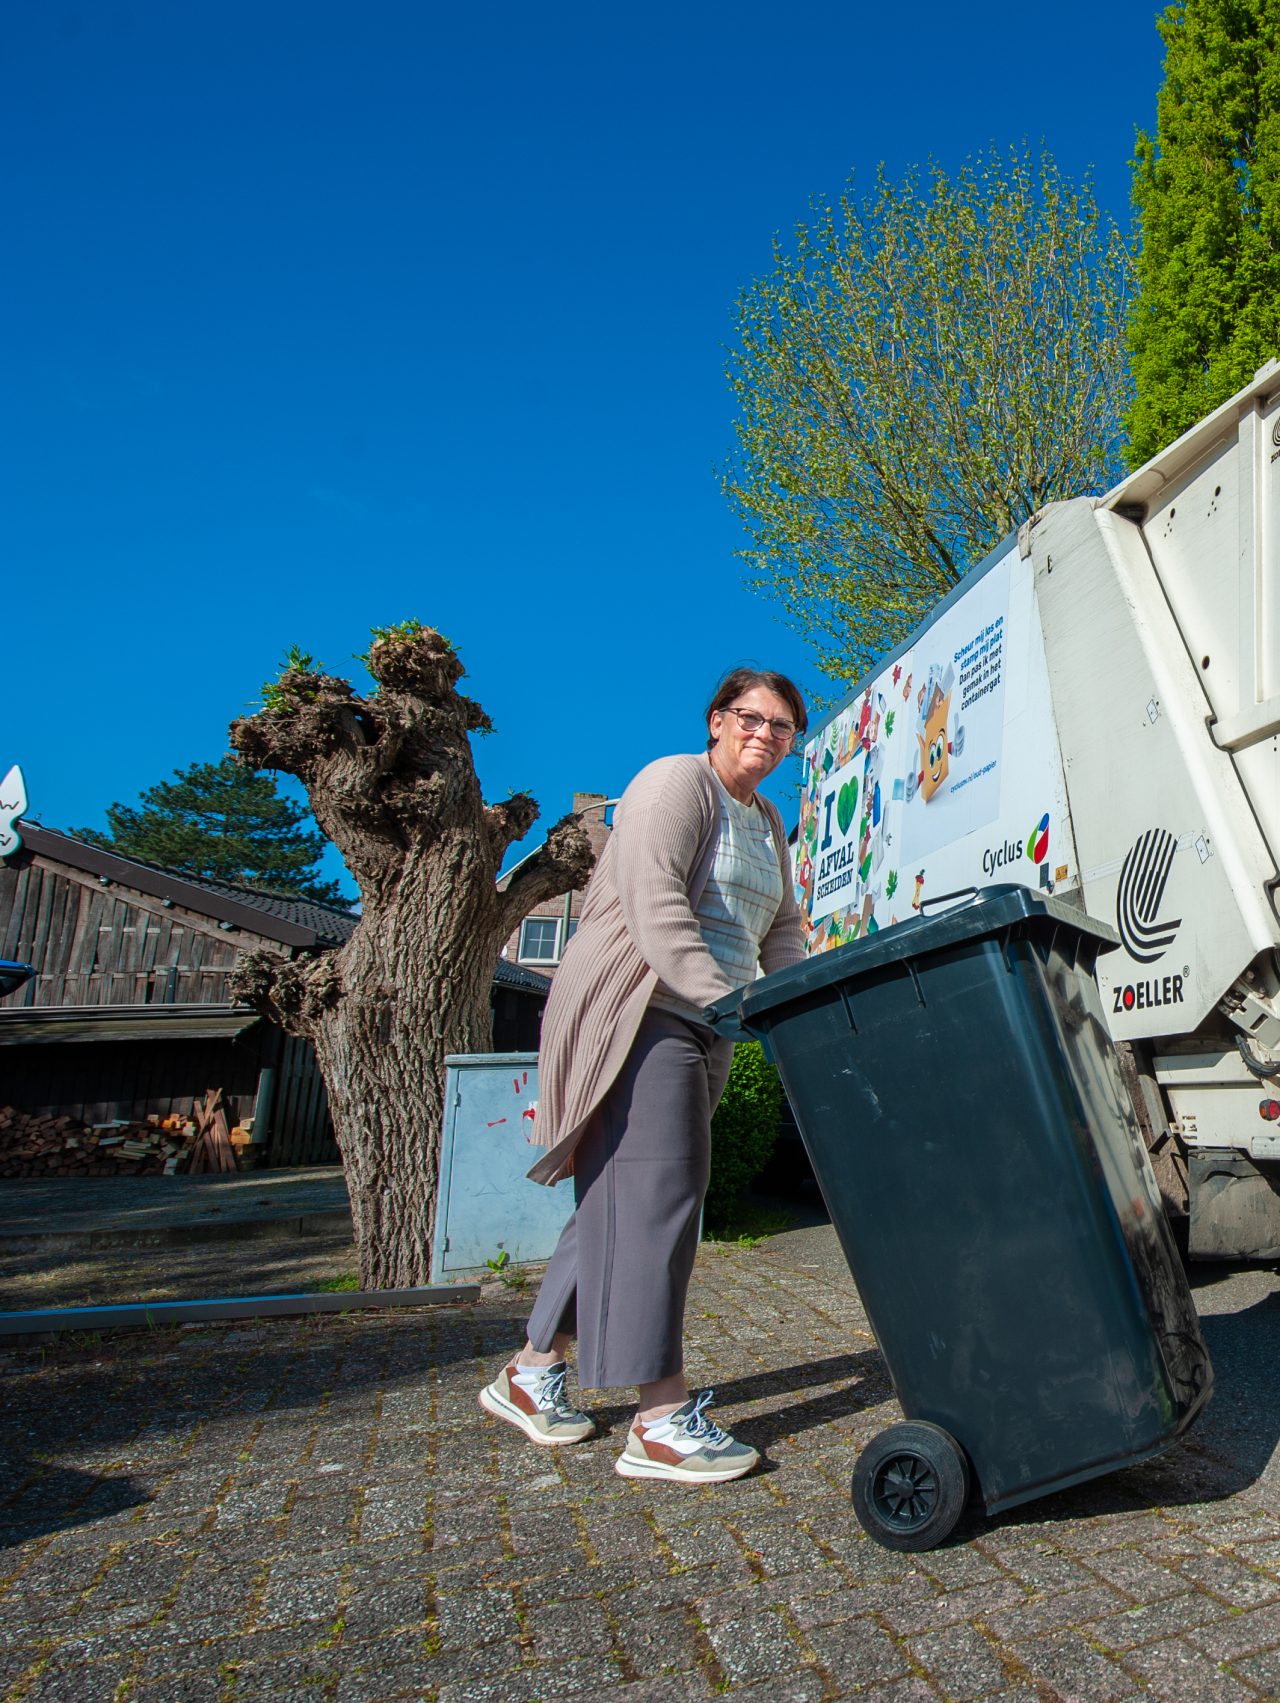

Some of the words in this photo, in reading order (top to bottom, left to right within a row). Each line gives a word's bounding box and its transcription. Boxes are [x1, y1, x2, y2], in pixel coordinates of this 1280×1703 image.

[954, 640, 975, 663] Scheur
[975, 629, 985, 646] mij
[985, 624, 995, 637] los
[995, 616, 1004, 628] en
[961, 650, 979, 671] stamp
[980, 639, 990, 656] mij
[990, 629, 1003, 650] plat
[960, 670, 970, 685] Dan
[971, 661, 982, 678] pas
[983, 655, 989, 667] ik
[989, 644, 1002, 660] met
[963, 674, 983, 699] gemak
[983, 669, 990, 681] in
[990, 658, 1002, 676] het
[961, 673, 1001, 711] containergat
[821, 790, 836, 852] I
[818, 841, 854, 882] AFVAL
[982, 839, 1023, 877] Cyclus
[816, 868, 854, 901] SCHEIDEN
